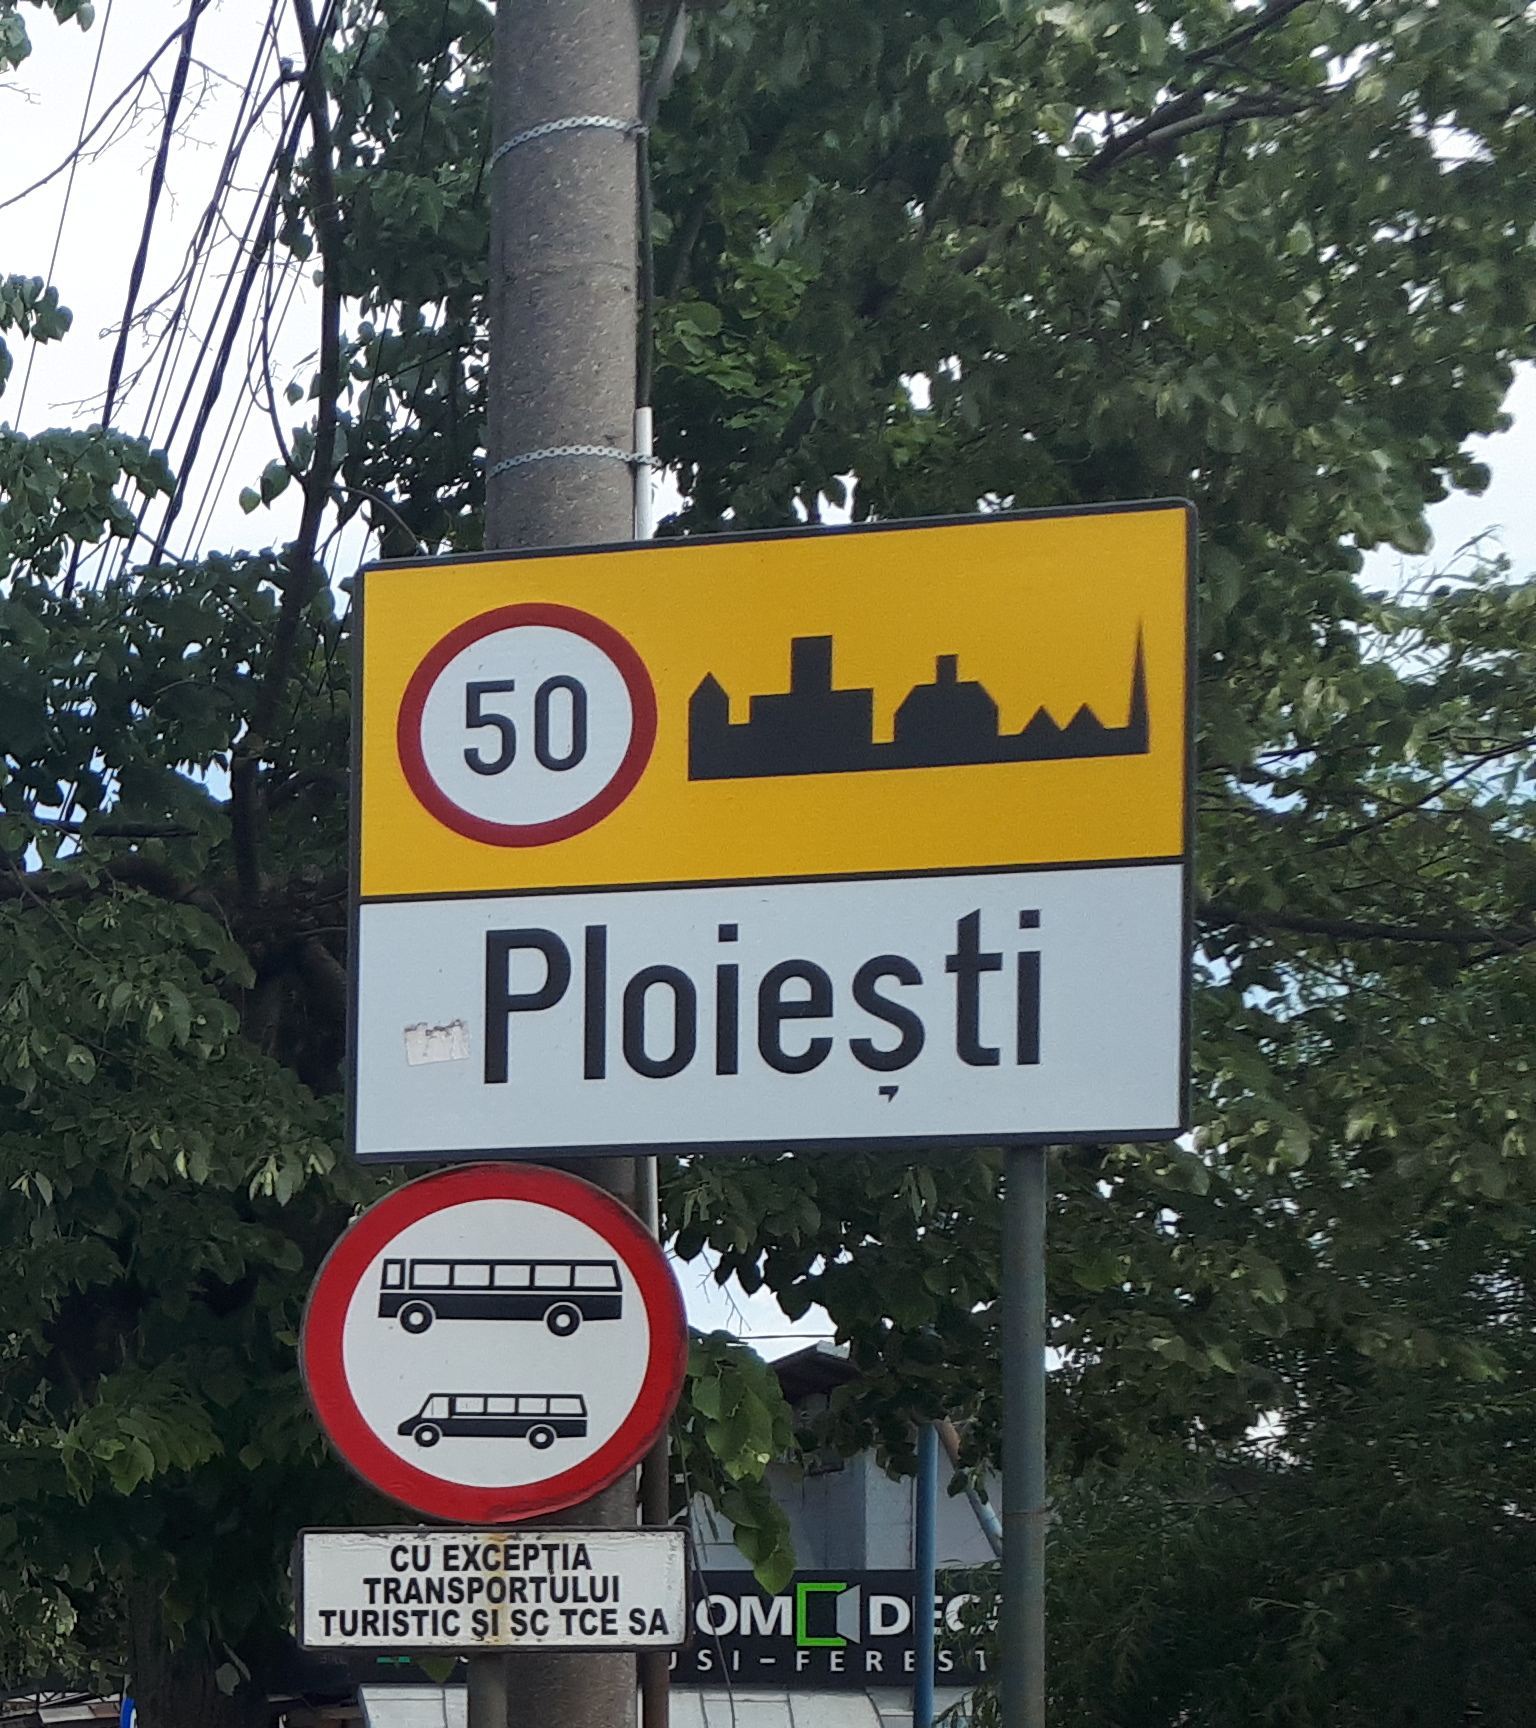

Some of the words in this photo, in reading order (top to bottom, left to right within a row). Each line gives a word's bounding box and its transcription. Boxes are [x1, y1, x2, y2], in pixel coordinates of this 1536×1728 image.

[463, 674, 589, 777] 50
[483, 908, 1043, 1103] Ploiești
[390, 1544, 431, 1572] CU
[363, 1575, 620, 1605] TRANSPORTULUI
[319, 1608, 461, 1637] TURISTIC
[510, 1608, 550, 1637] SC
[559, 1608, 619, 1636] TCE
[628, 1608, 670, 1636] SA
